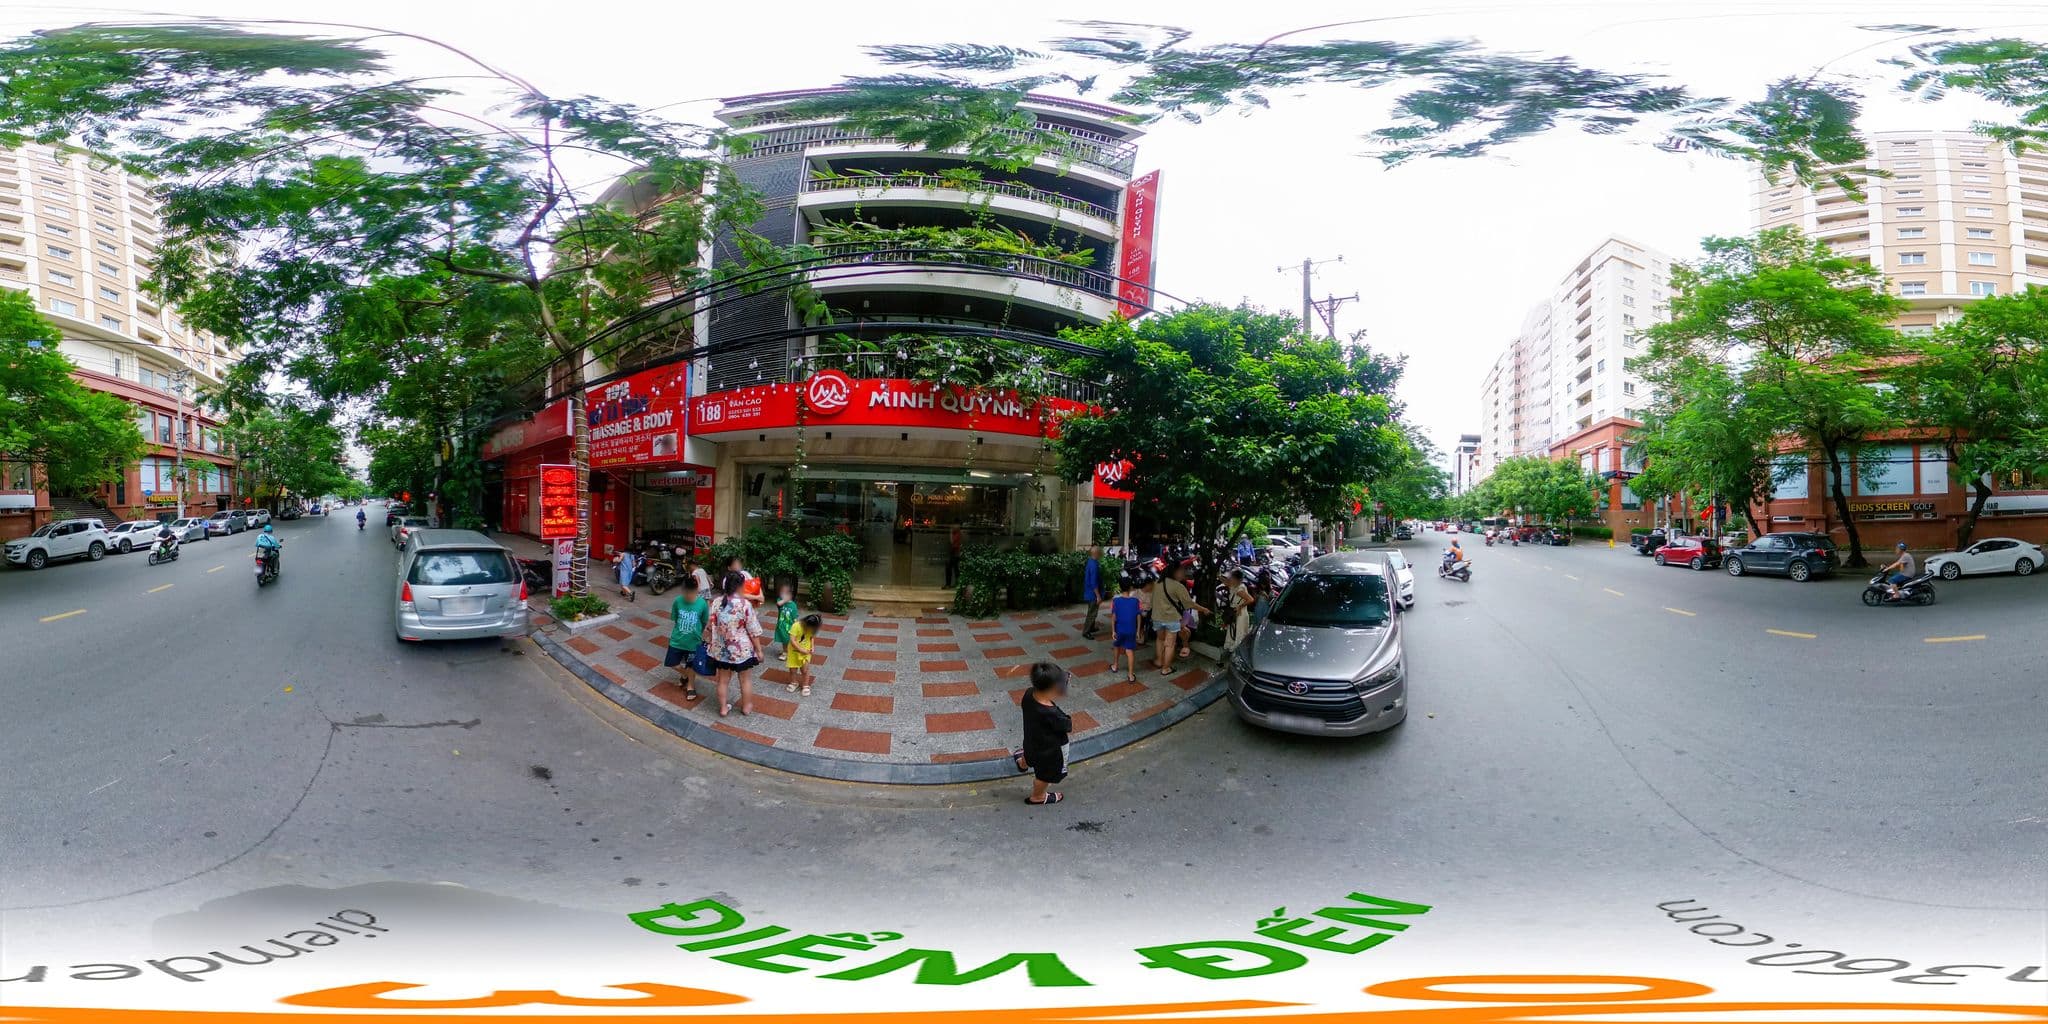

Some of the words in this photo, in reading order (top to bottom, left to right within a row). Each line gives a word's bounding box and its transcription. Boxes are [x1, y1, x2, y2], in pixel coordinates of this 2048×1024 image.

[745, 398, 762, 406] CAO
[868, 391, 934, 409] MINH
[700, 404, 721, 422] 188
[592, 419, 632, 441] MASSAGE
[633, 416, 642, 431] &
[643, 411, 674, 429] BODY
[648, 475, 695, 487] welcome
[1848, 503, 1874, 512] IENDS
[1875, 502, 1910, 512] SCREEN
[1913, 502, 1933, 511] GOLF
